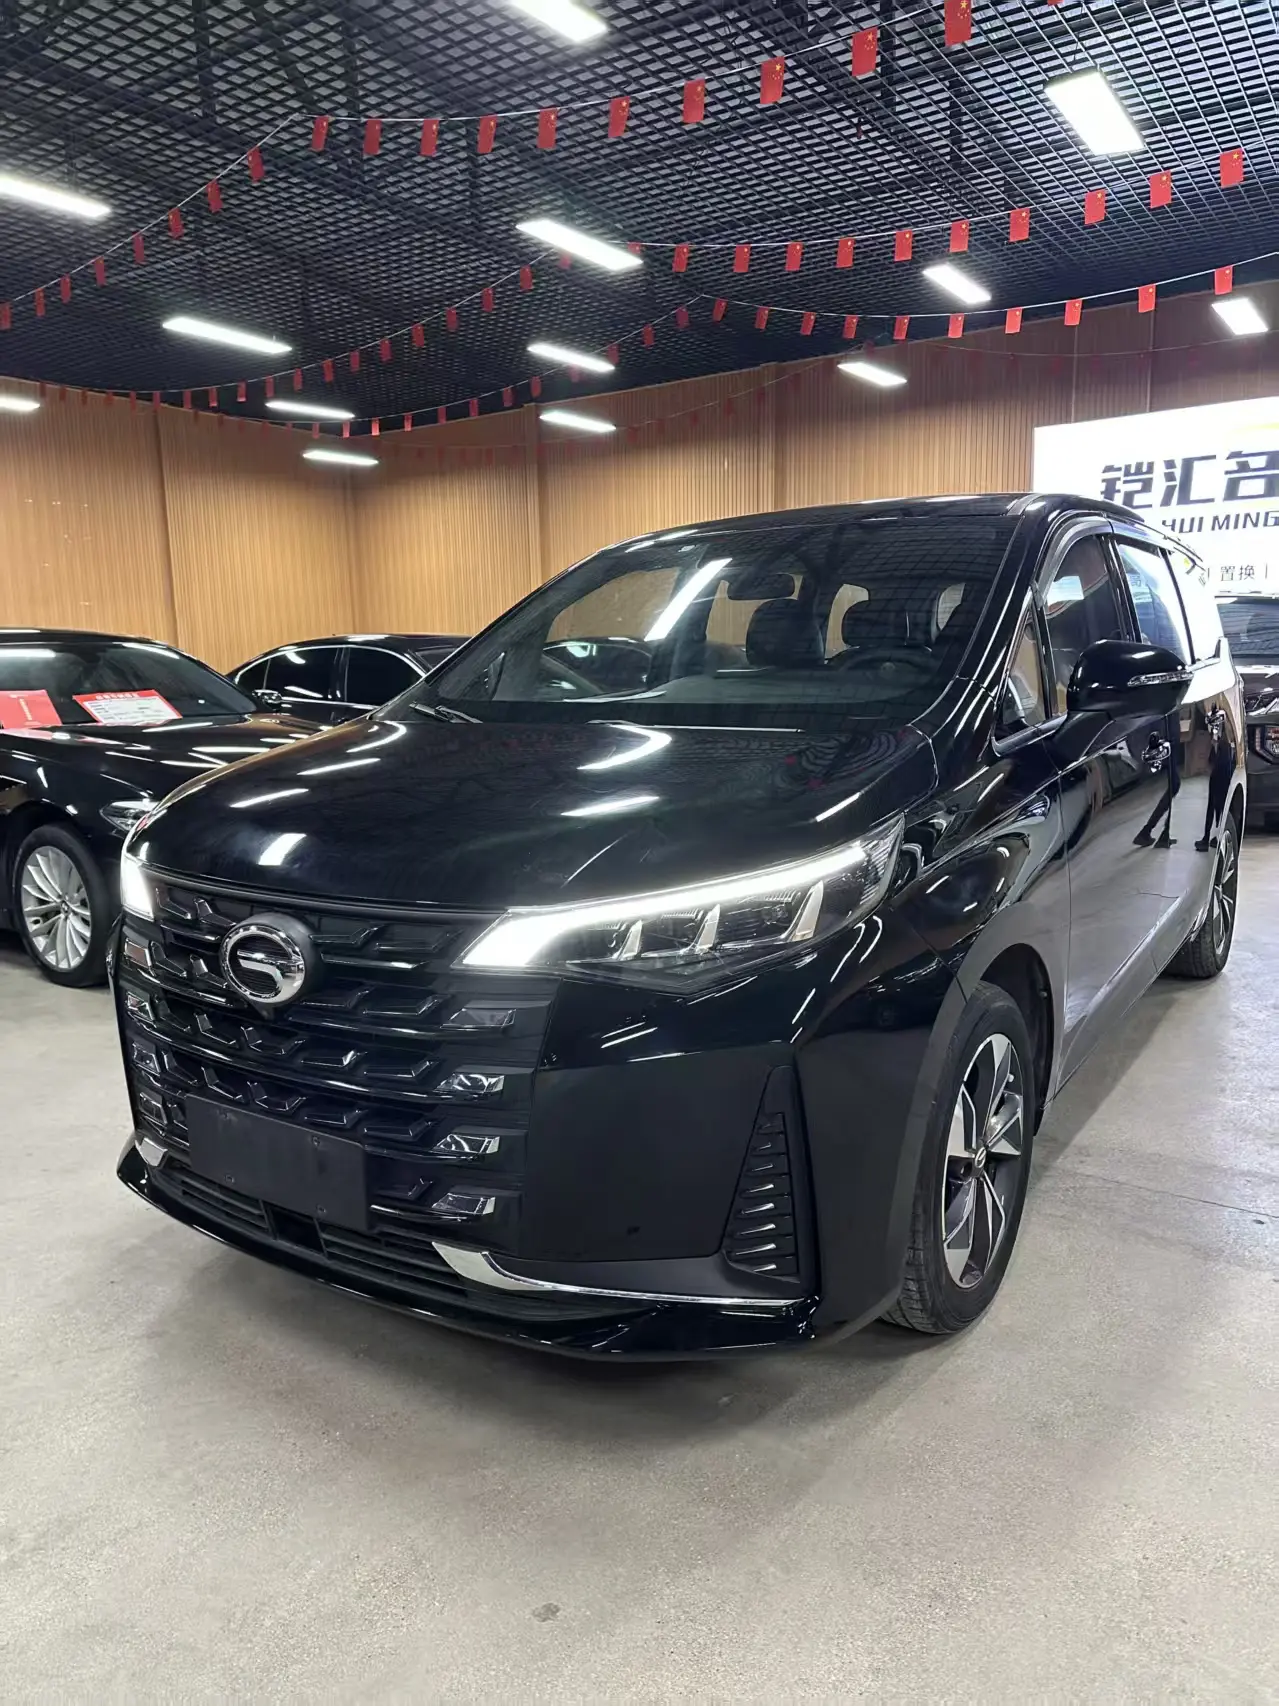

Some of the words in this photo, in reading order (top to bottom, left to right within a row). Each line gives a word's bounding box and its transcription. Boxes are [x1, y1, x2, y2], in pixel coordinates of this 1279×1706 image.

[1100, 450, 1279, 509] 铠汇名
[1211, 510, 1279, 531] MING
